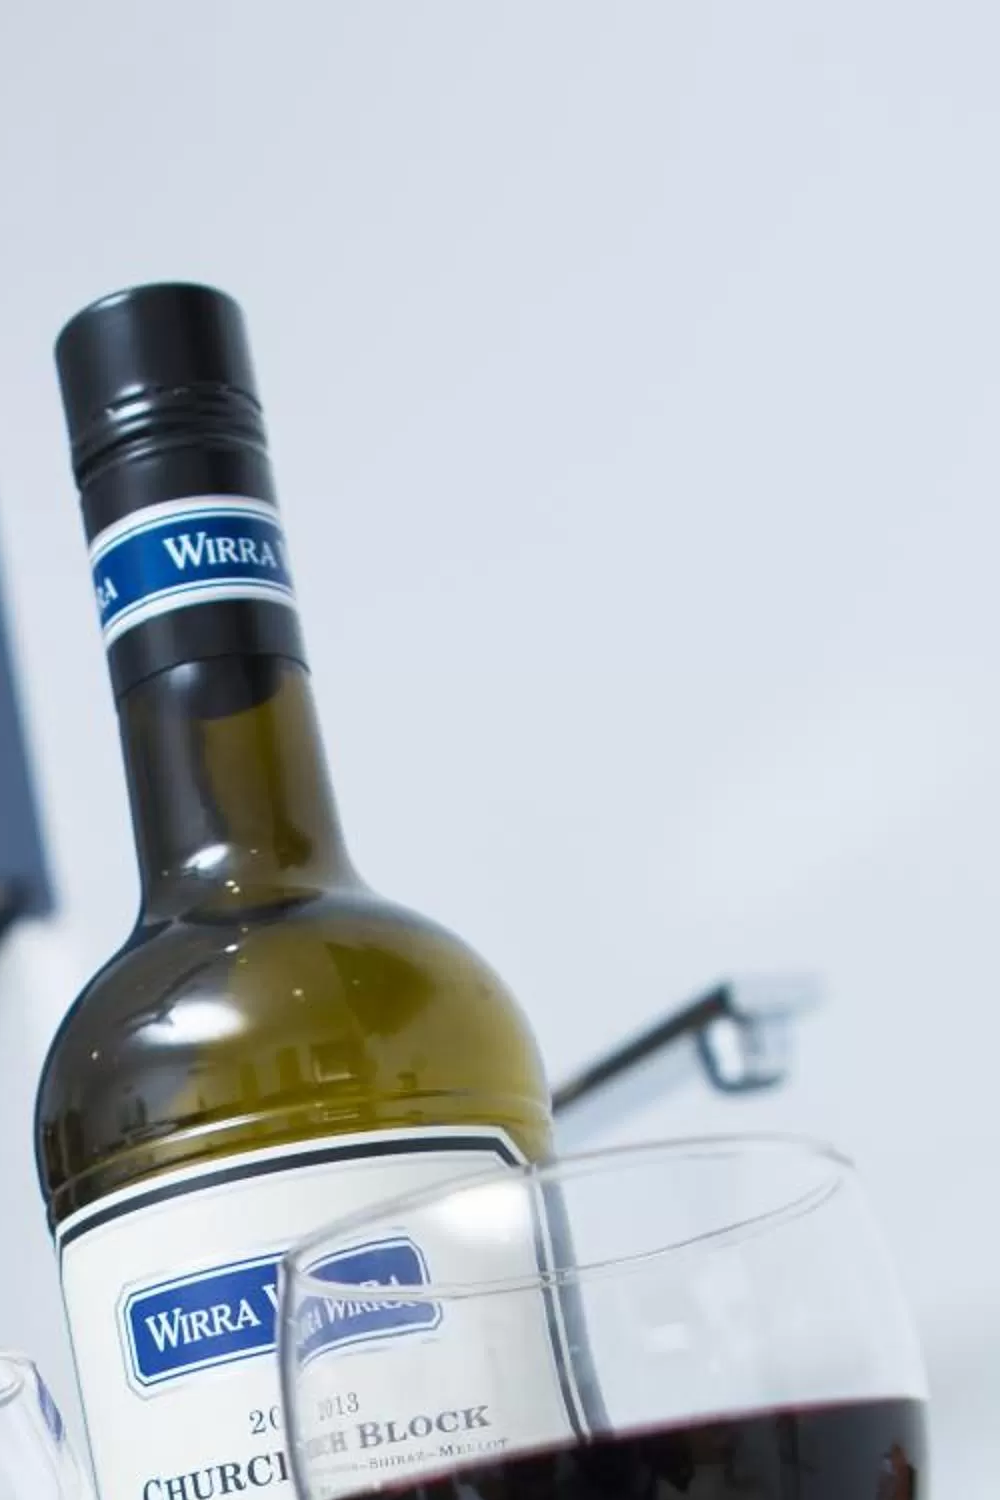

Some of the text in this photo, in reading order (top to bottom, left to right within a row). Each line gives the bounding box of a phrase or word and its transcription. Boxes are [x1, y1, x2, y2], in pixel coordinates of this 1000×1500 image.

[163, 532, 277, 571] WIRRA
[145, 1298, 261, 1354] WIRRA
[356, 1404, 491, 1450] BLOCK
